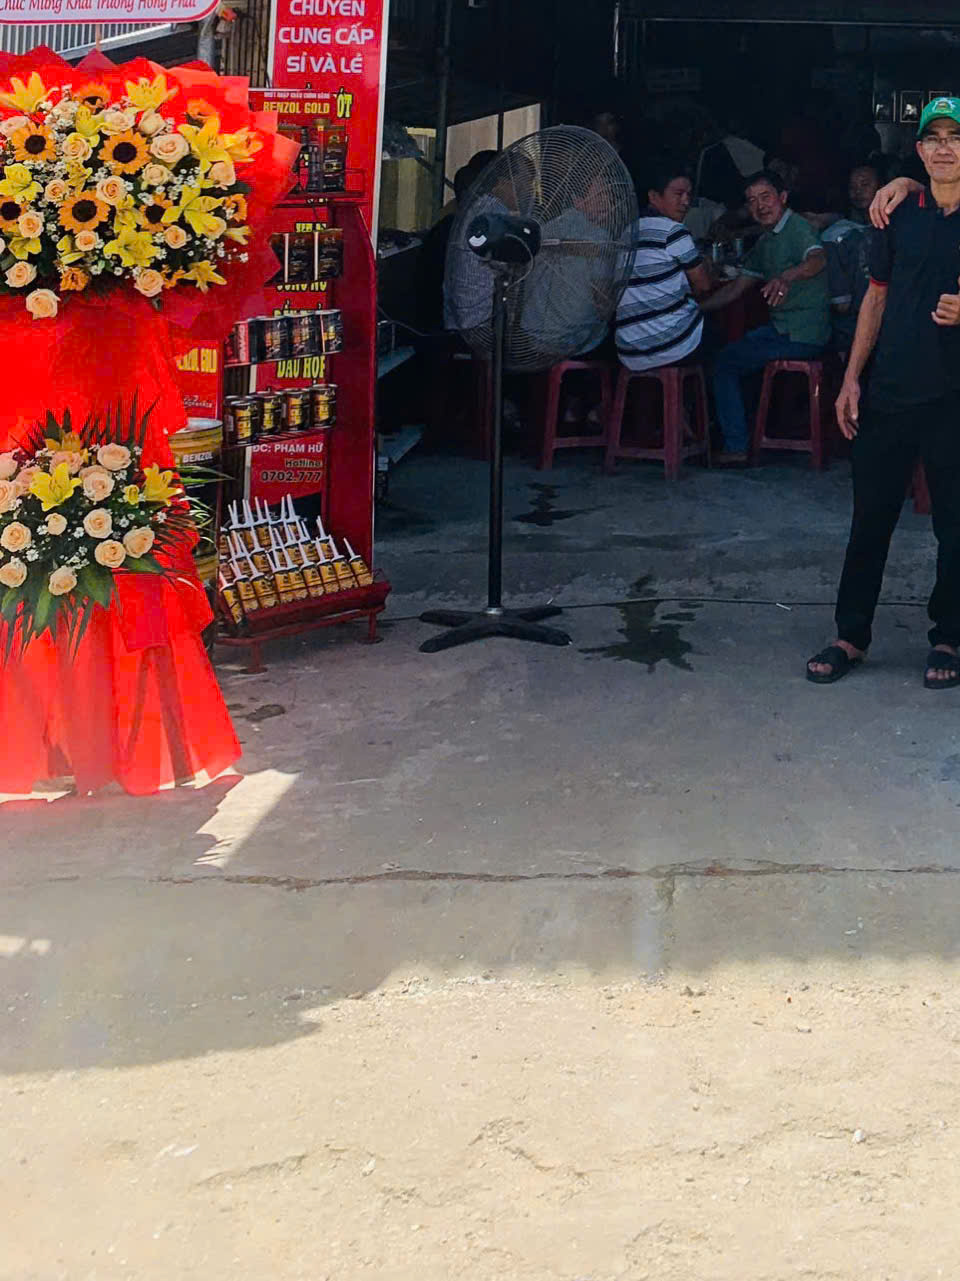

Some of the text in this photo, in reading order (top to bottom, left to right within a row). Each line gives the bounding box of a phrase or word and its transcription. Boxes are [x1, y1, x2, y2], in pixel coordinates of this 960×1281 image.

[279, 22, 374, 44] CUNG CẤP
[310, 52, 337, 73] VÀ
[304, 102, 330, 114] GOLD
[274, 443, 305, 455] PHẠM
